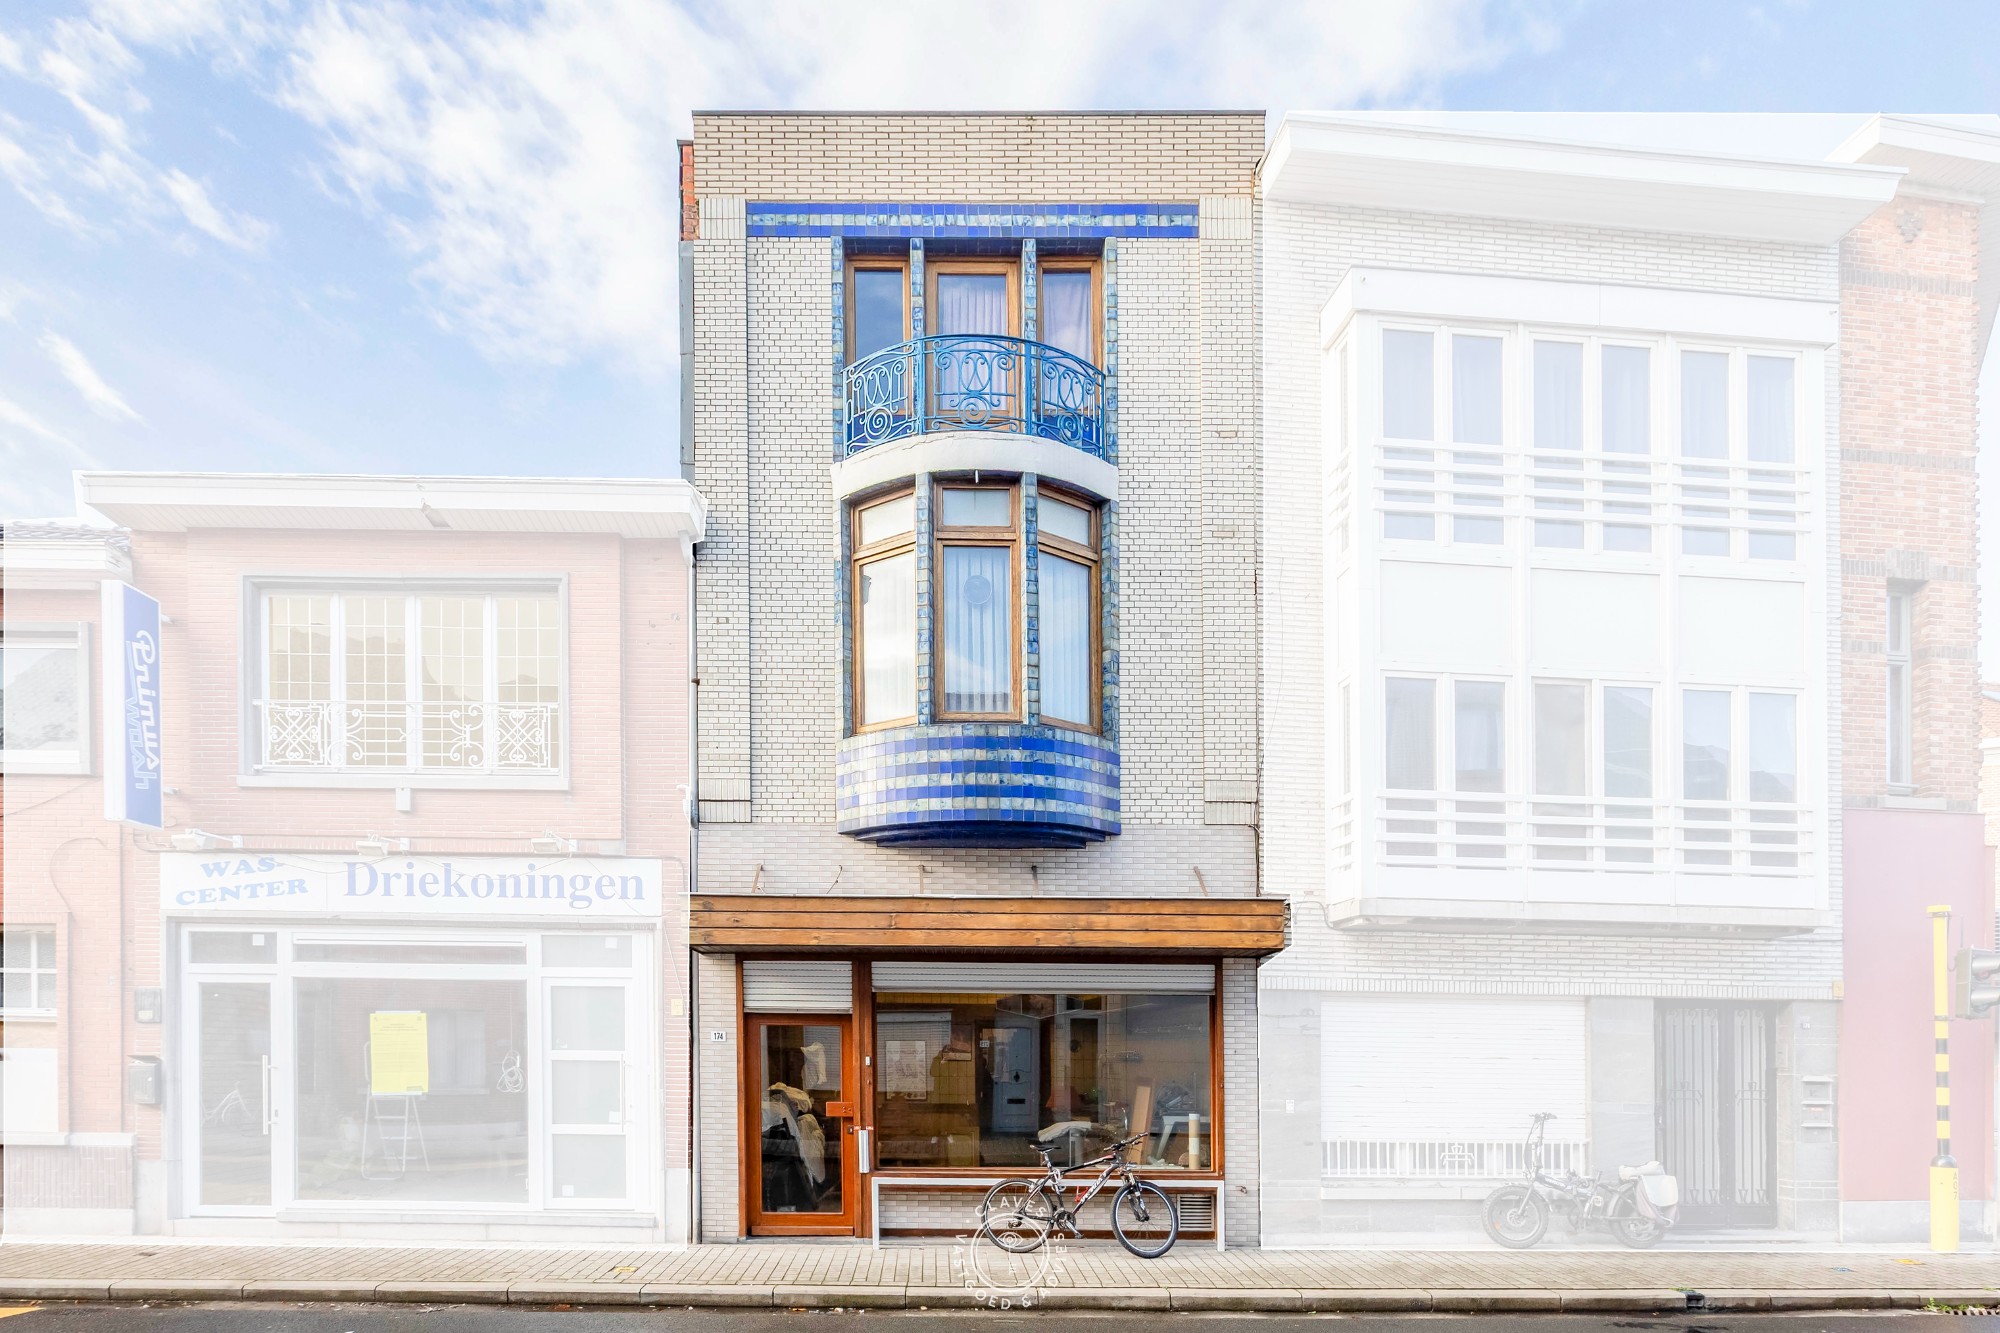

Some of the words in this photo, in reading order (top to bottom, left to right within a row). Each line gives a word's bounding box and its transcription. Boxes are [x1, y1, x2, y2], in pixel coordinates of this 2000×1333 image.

[133, 630, 160, 770] Primus
[175, 879, 308, 906] CENTER
[343, 861, 645, 909] Driekoningen
